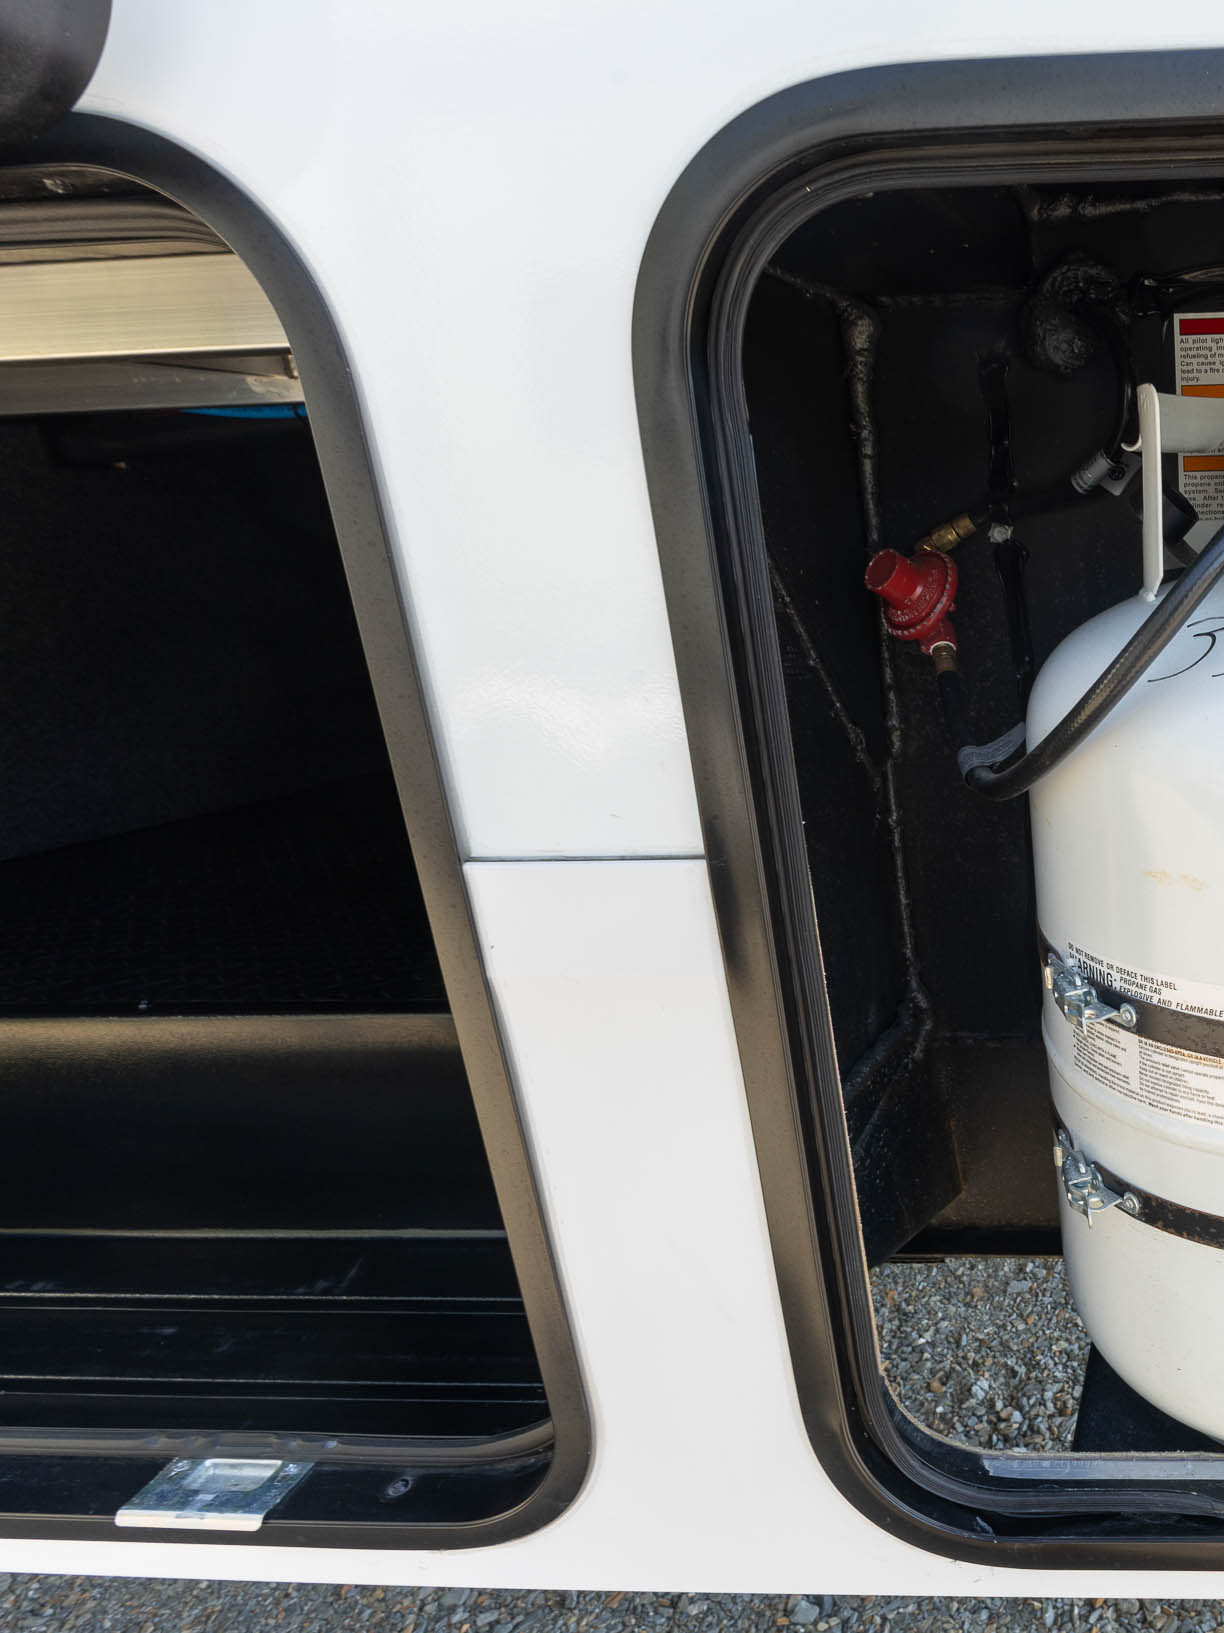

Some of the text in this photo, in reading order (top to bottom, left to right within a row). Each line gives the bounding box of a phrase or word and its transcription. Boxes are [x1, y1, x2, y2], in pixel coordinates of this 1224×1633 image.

[1192, 337, 1207, 345] pilot
[1180, 345, 1212, 353] operating
[1180, 352, 1208, 360] refueling
[1181, 375, 1200, 383] injury.
[1069, 952, 1117, 989] ARNING:
[1075, 947, 1084, 957] NOT
[1084, 952, 1104, 967] REMOVE
[1106, 962, 1114, 971] OR
[1116, 966, 1138, 980] DEFACE
[1140, 974, 1154, 985] THIS
[1119, 977, 1162, 996] PROPANE GAS
[1119, 986, 1224, 1018] EXPLOSIVE AND FLAMMABLE
